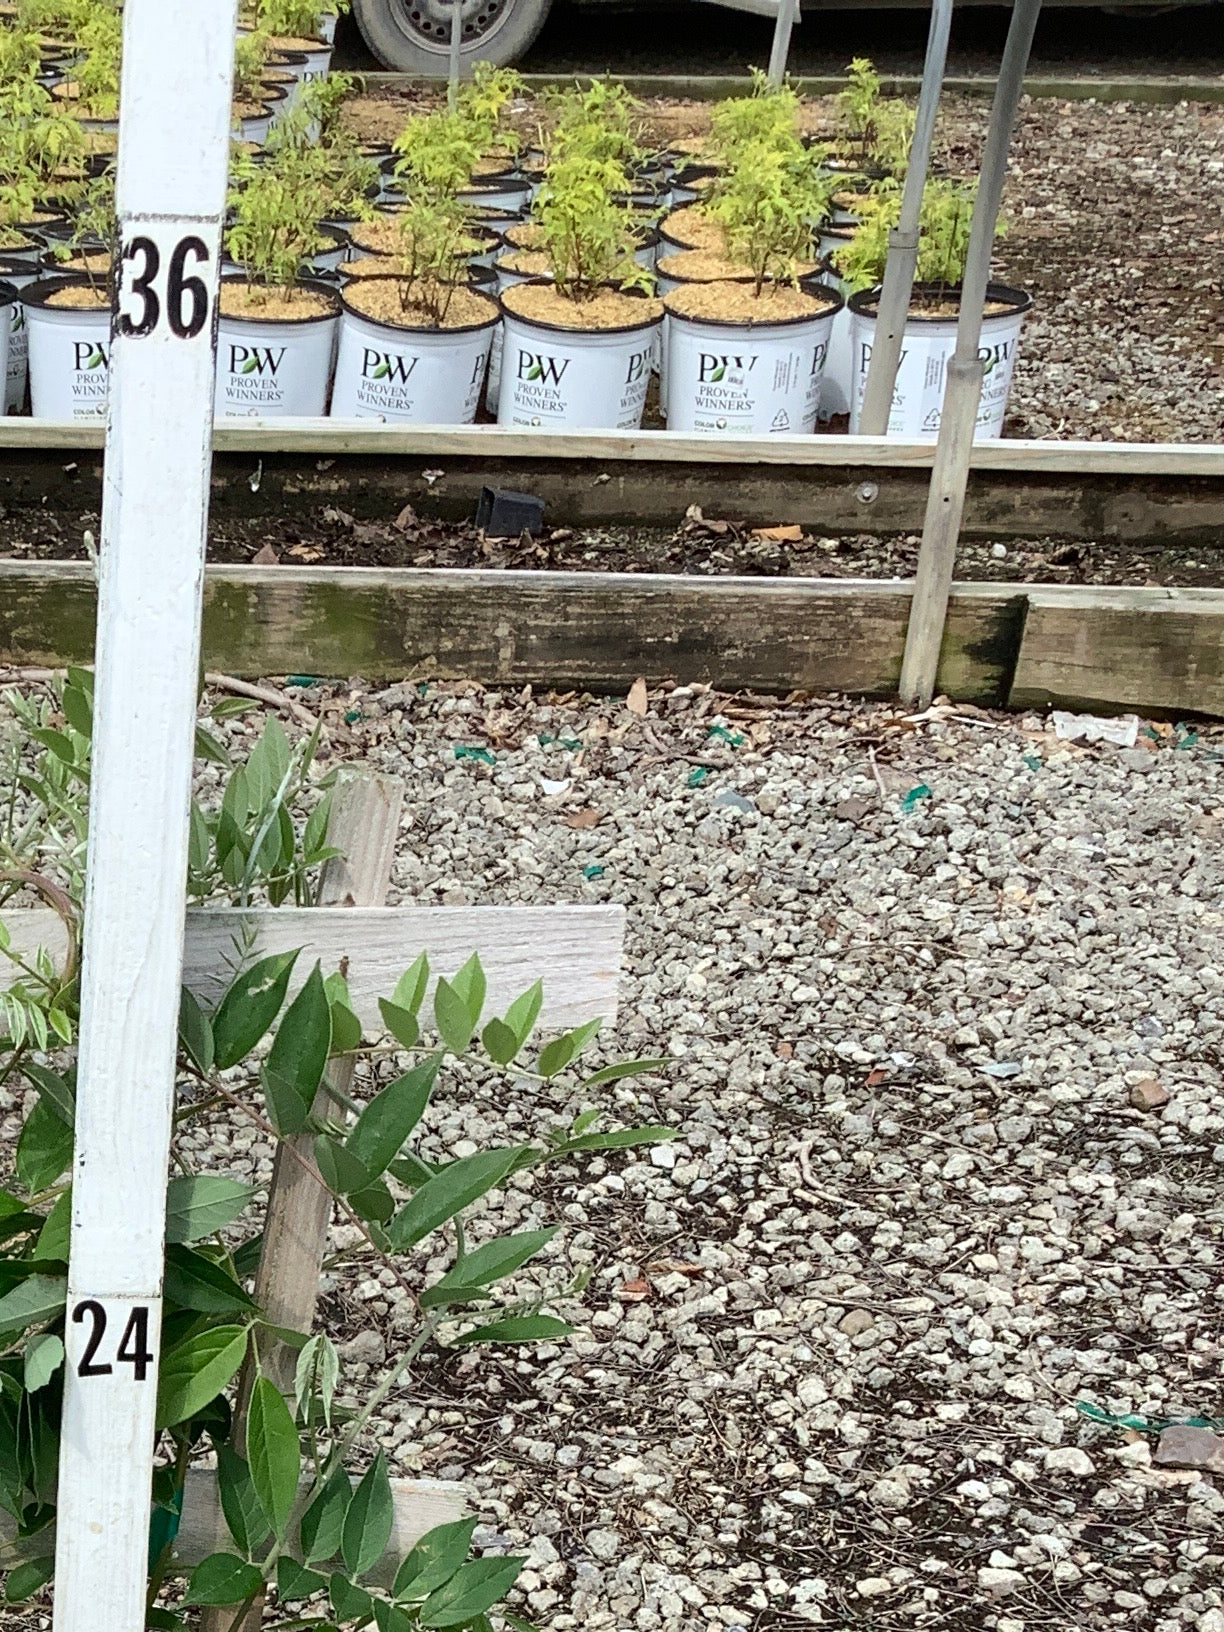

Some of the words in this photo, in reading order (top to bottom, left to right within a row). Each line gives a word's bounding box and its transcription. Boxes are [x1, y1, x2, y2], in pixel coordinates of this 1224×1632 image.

[118, 235, 209, 339] 36
[228, 344, 288, 376] PW
[360, 347, 420, 384] PW
[517, 349, 571, 386] PW
[77, 374, 107, 383] PROV
[230, 377, 278, 388] PROVEN
[72, 386, 106, 395] WINN
[226, 388, 281, 400] WINNERS
[362, 380, 408, 397] PROVEN
[518, 382, 561, 399] PROVEN
[357, 390, 411, 410] WINNERS
[514, 393, 564, 411] WINNERS
[695, 397, 752, 410] WINNERS
[72, 1299, 153, 1381] 24
